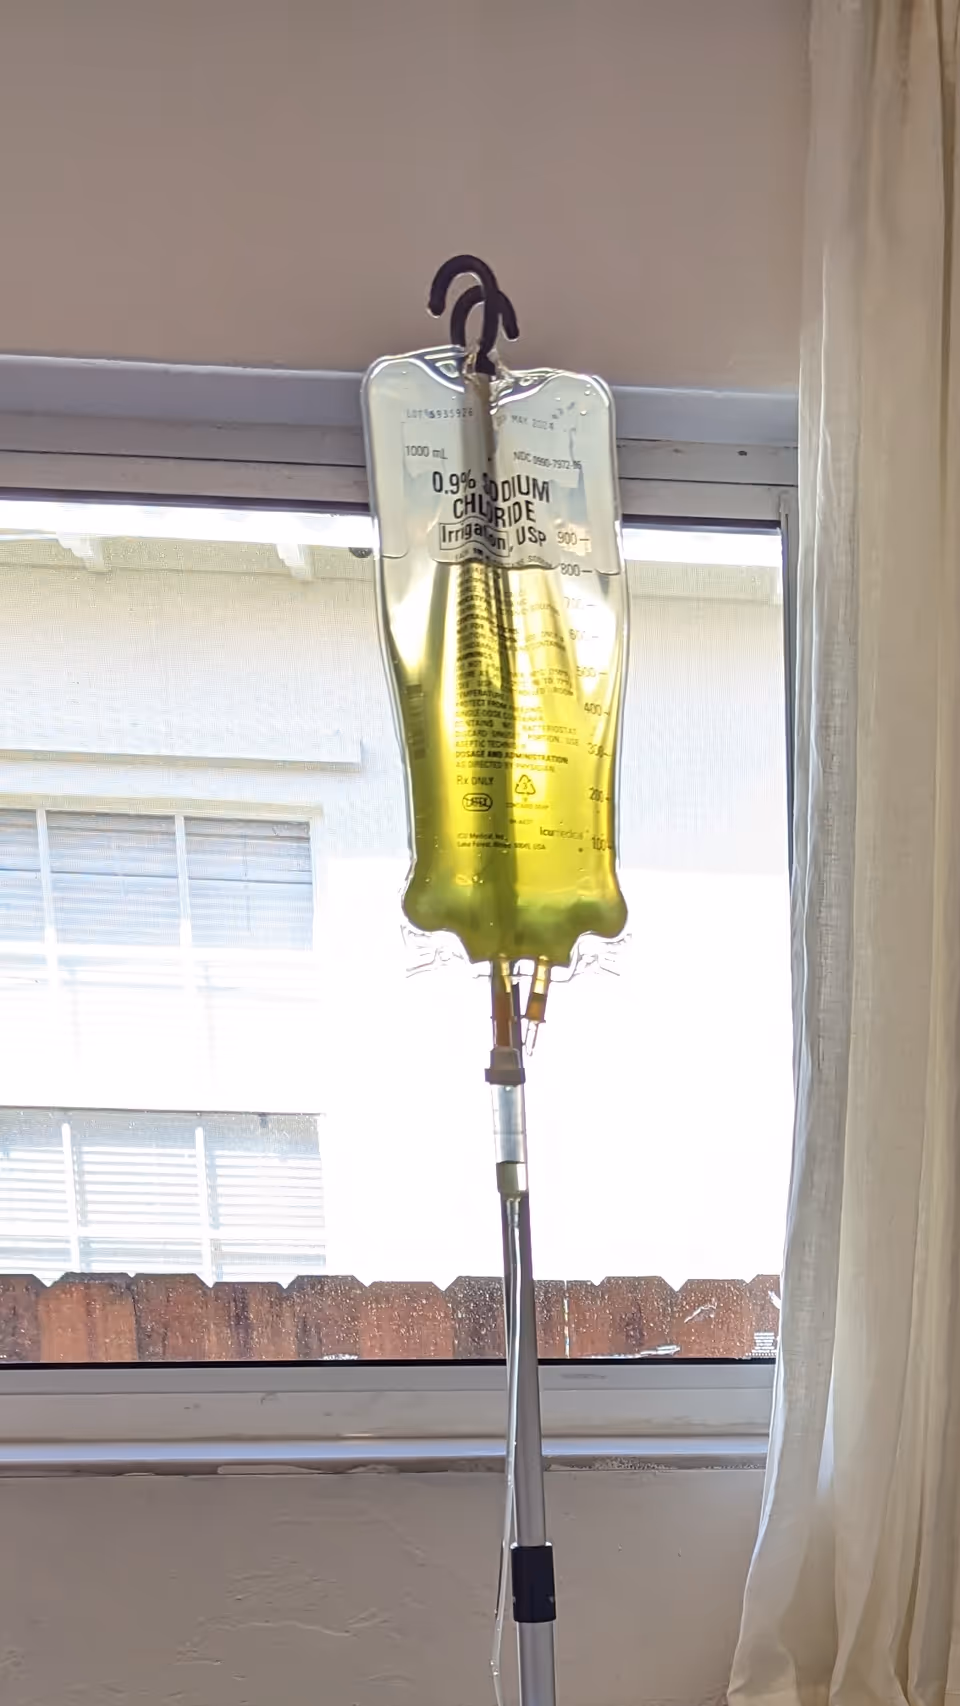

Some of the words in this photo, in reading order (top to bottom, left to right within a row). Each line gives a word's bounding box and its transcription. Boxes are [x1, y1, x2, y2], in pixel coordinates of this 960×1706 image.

[405, 445, 430, 457] 1000
[432, 448, 448, 460] mL
[432, 469, 476, 495] 0.9%
[453, 493, 536, 528] CHLORIDE
[516, 526, 546, 547] USP
[557, 531, 577, 545] 900
[560, 563, 581, 577] 800
[584, 702, 602, 716] 400
[487, 750, 503, 758] AND
[471, 776, 495, 785] ONLY
[588, 788, 604, 803] 200
